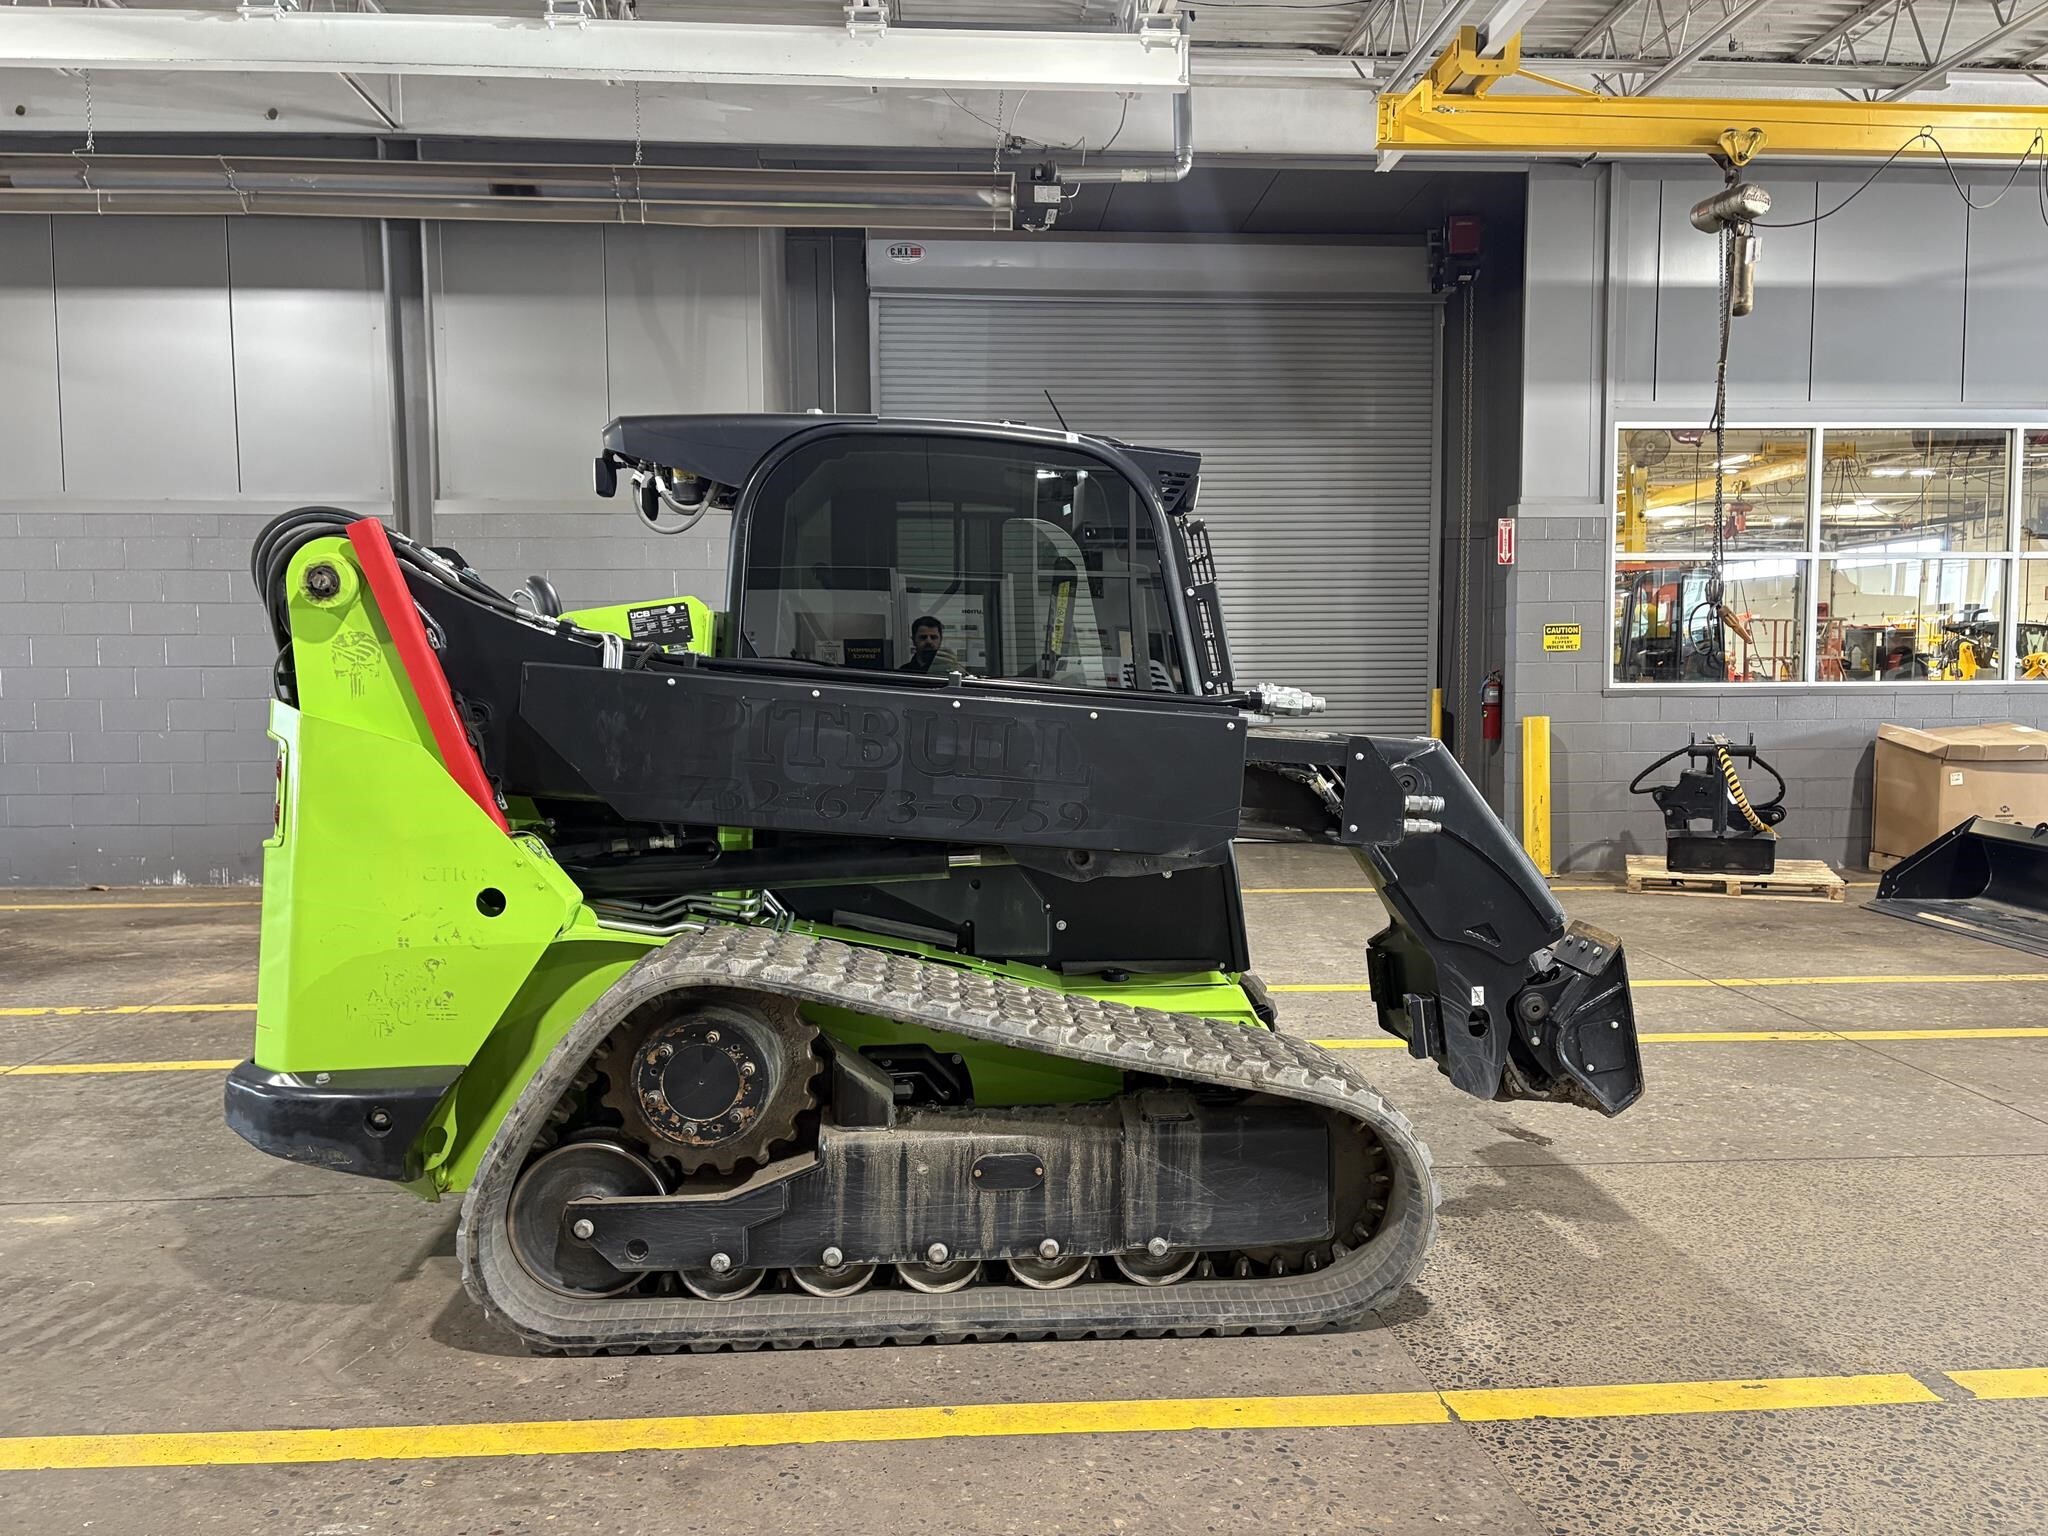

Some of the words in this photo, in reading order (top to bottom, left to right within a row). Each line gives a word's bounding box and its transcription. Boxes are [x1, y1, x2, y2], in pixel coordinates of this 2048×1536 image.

[630, 610, 650, 619] JCB
[1546, 626, 1579, 634] CAUTION
[680, 774, 1091, 835] 732-673-9759
